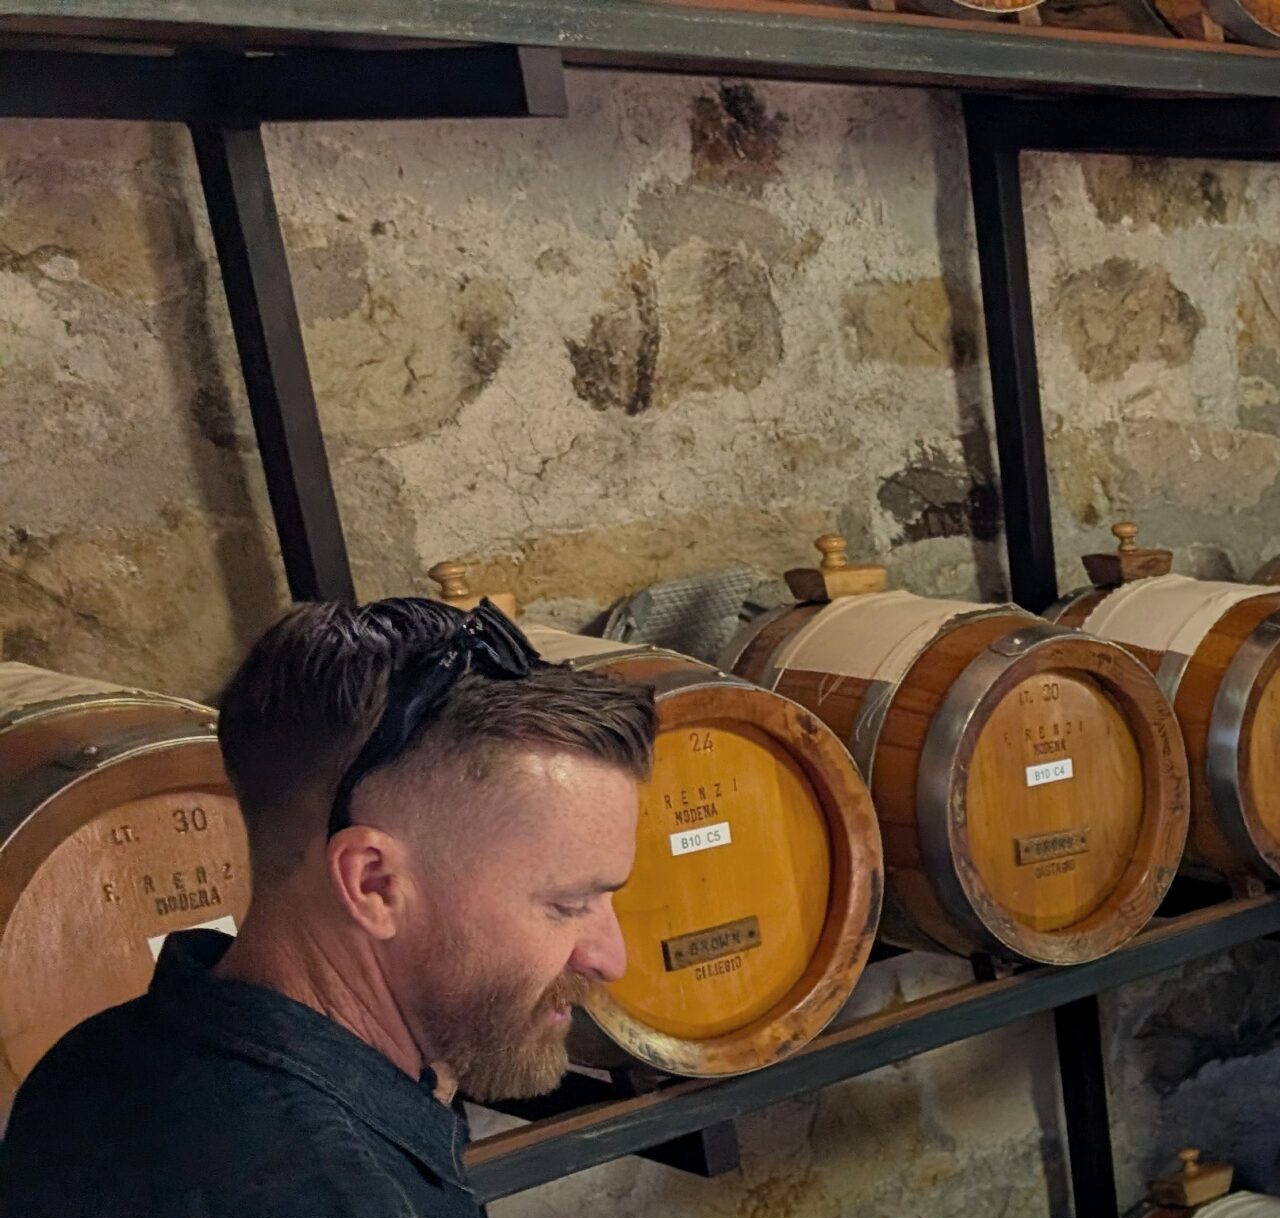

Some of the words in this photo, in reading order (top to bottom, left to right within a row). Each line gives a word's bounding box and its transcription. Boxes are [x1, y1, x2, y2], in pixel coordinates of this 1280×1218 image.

[690, 732, 714, 752] 24
[1035, 768, 1051, 781] B10
[1054, 765, 1065, 777] C4
[172, 807, 208, 833] 30
[674, 802, 718, 825] MODENA
[681, 834, 702, 849] B10
[706, 830, 721, 844] C5
[154, 885, 222, 916] MODENA
